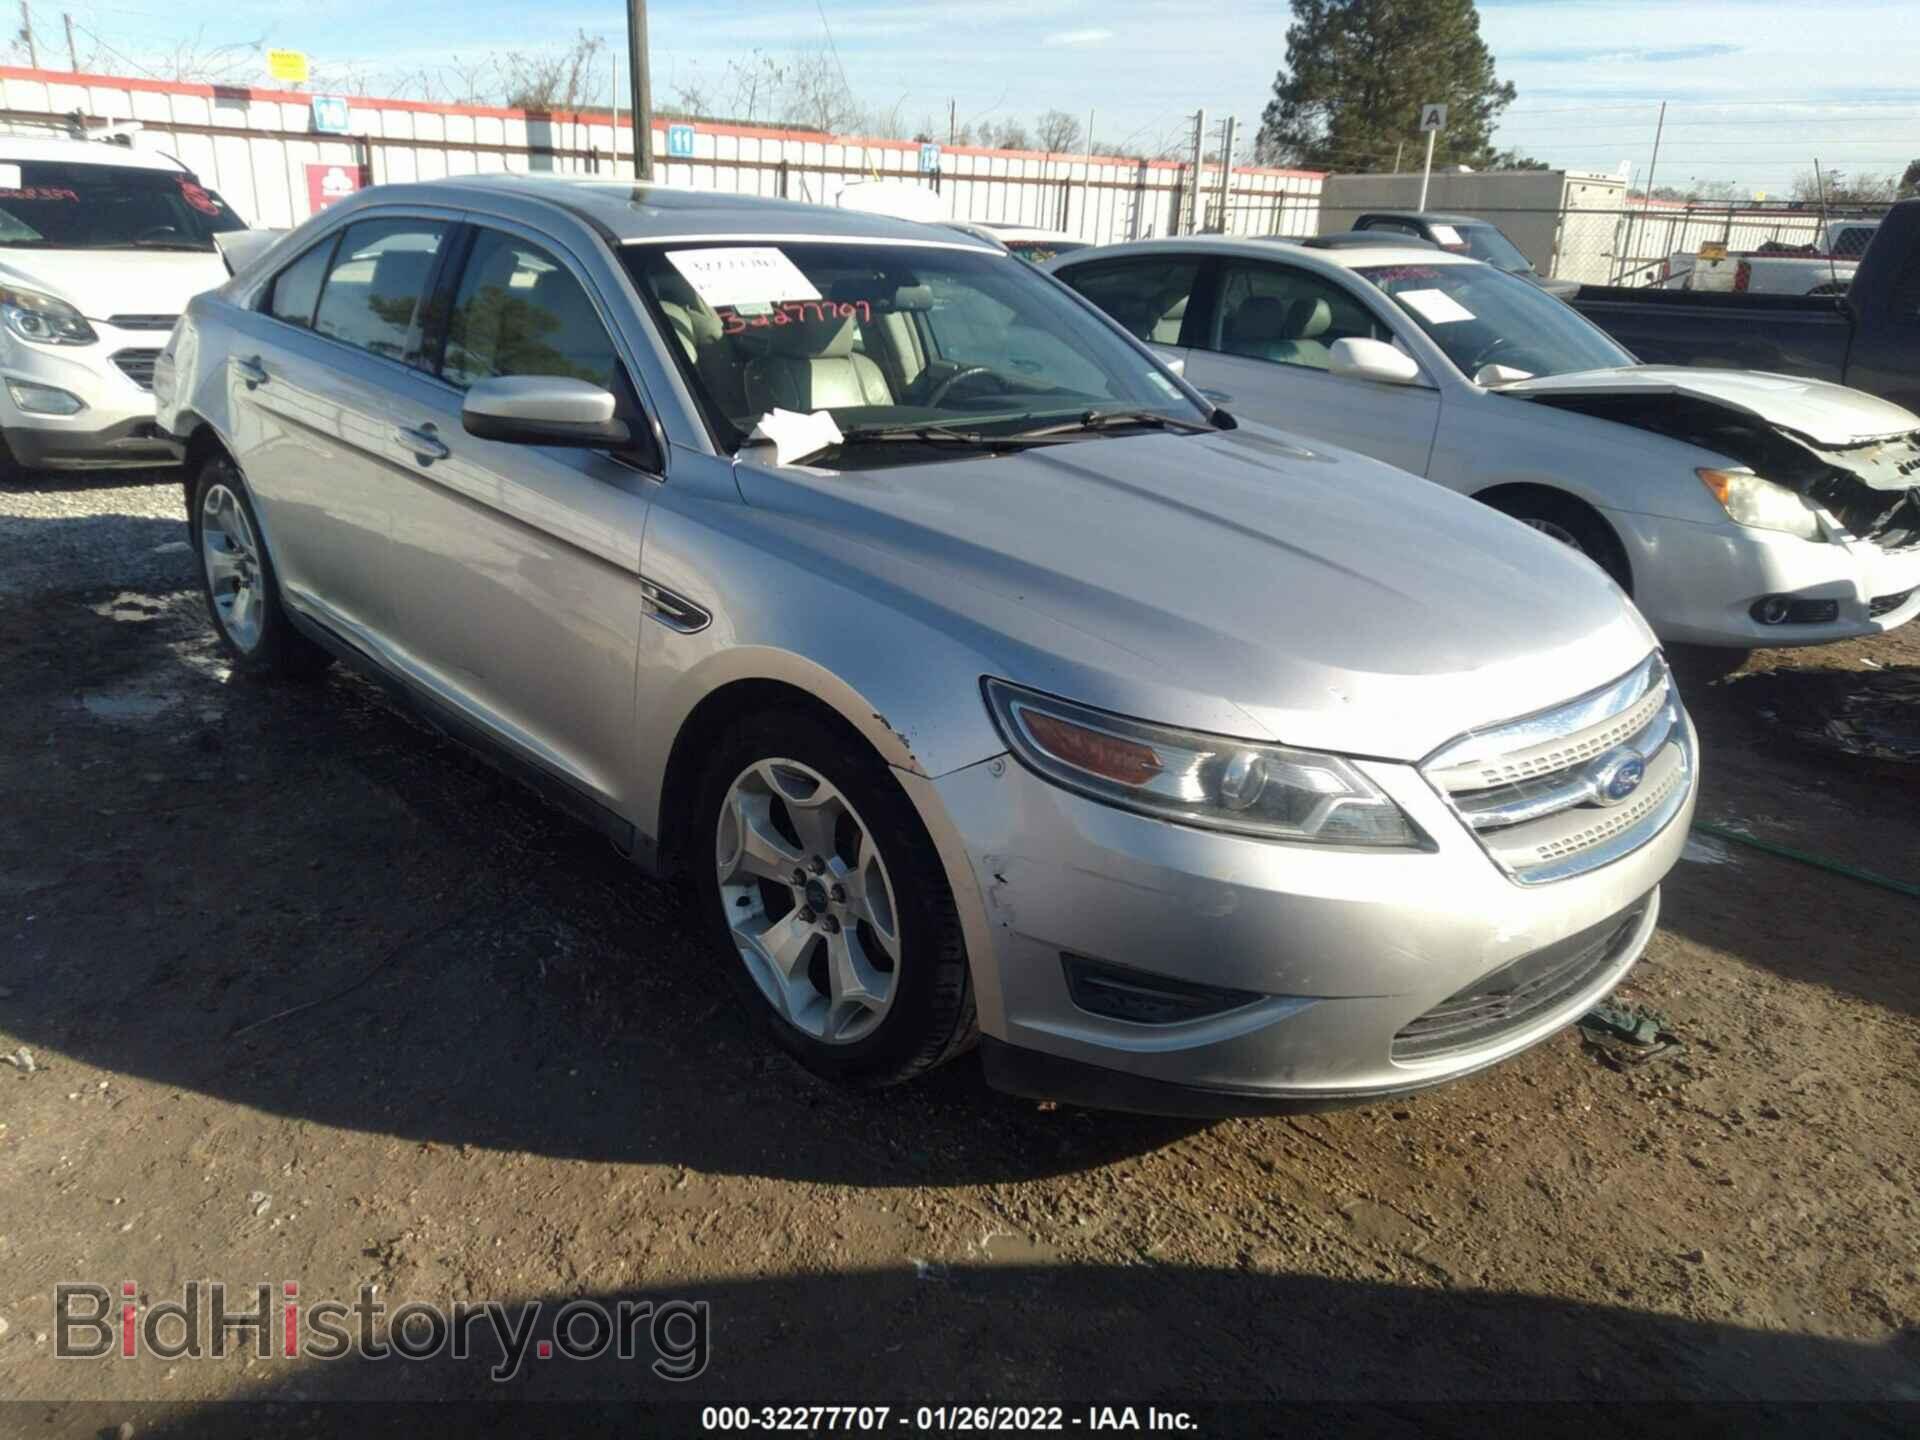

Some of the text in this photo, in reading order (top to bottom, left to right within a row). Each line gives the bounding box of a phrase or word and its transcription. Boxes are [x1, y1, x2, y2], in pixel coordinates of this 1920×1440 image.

[1425, 109, 1441, 126] A
[673, 130, 690, 152] 11
[719, 299, 871, 334] 32277707
